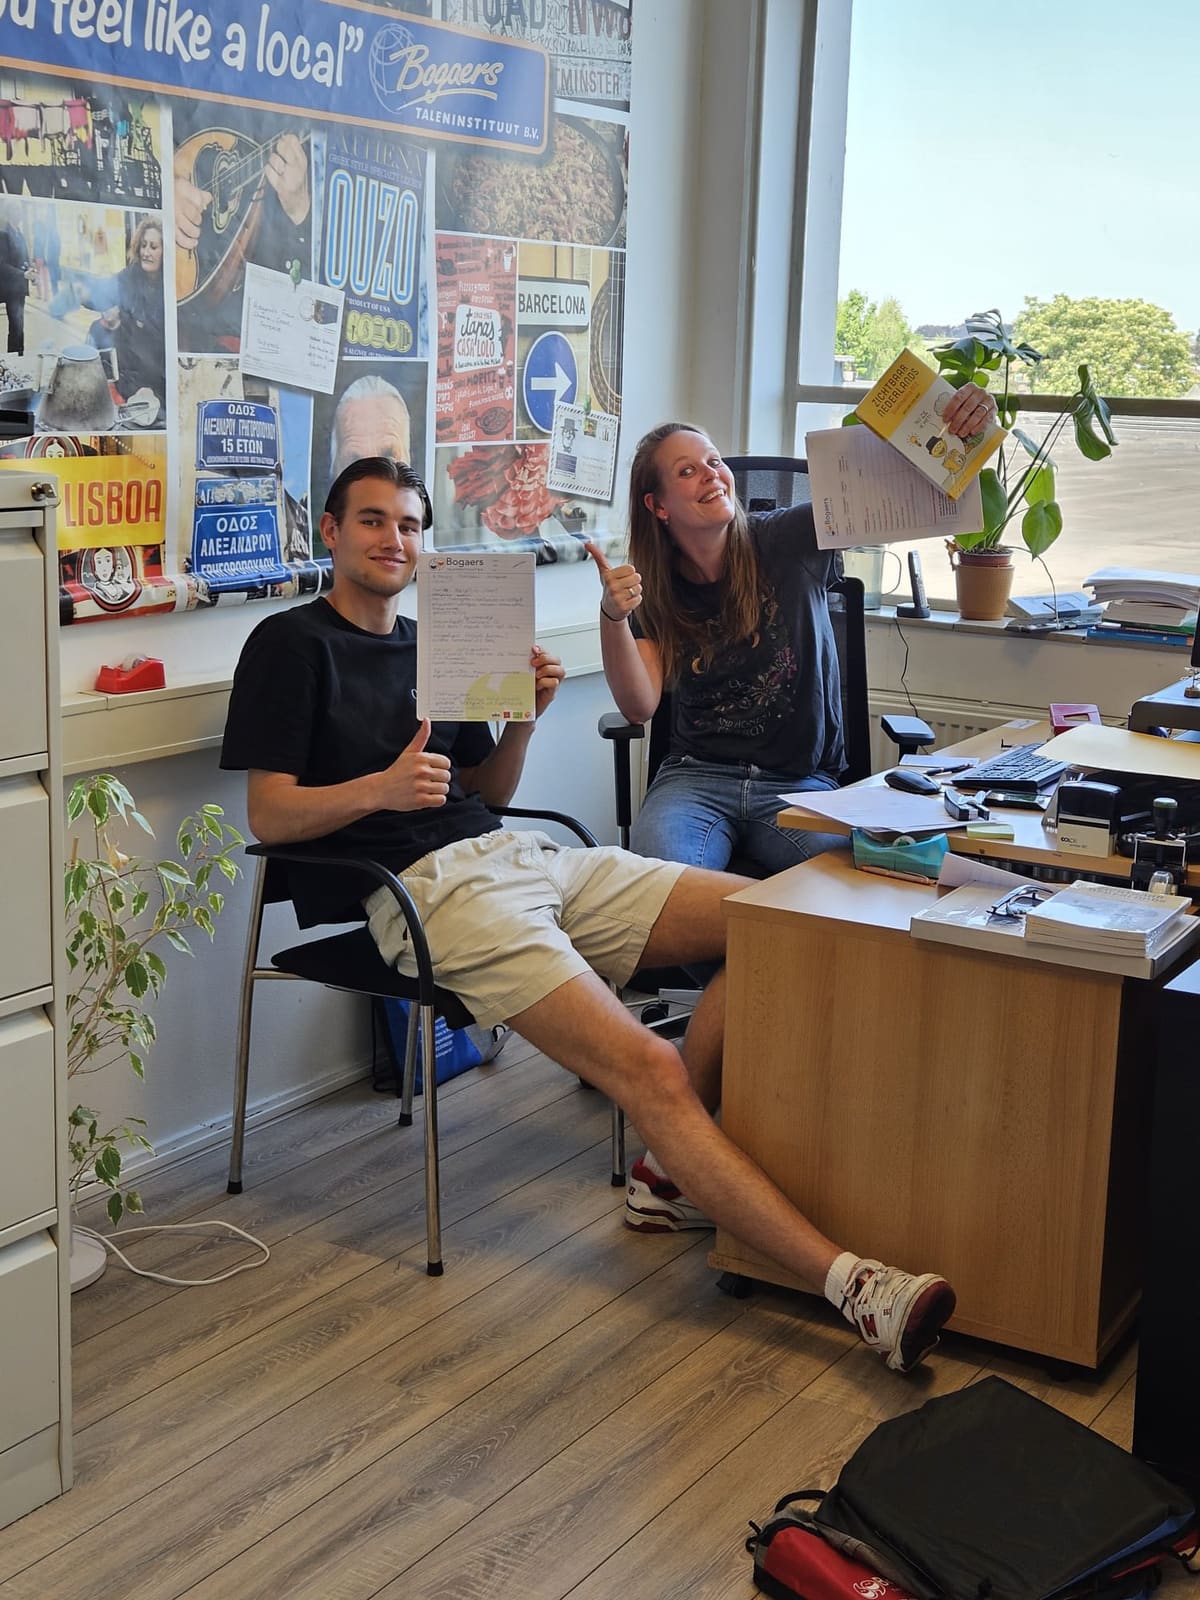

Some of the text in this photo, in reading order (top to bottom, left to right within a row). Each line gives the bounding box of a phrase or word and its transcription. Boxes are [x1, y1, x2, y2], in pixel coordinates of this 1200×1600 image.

[0, 0, 36, 29] u
[50, 0, 132, 48] feel
[144, 0, 212, 63] like
[222, 22, 247, 71] a
[389, 44, 505, 104] Bogaers
[415, 107, 540, 140] TALENINSTITUUT B.V.
[325, 168, 419, 306] OUZO
[518, 292, 587, 316] BARCELONA
[460, 307, 495, 345] tapas
[477, 338, 495, 358] LOLO
[872, 364, 909, 407] ZICHTBAAR
[228, 403, 256, 417] ΟΔΟΣ
[221, 438, 263, 455] 15 ΕΤΩΝ
[64, 479, 162, 528] LISBOA
[216, 515, 258, 533] ΟΔΟΣ
[200, 534, 272, 557] ΑΛΕΞΑΝΔΡΟΥ
[446, 557, 484, 568] Bogaers
